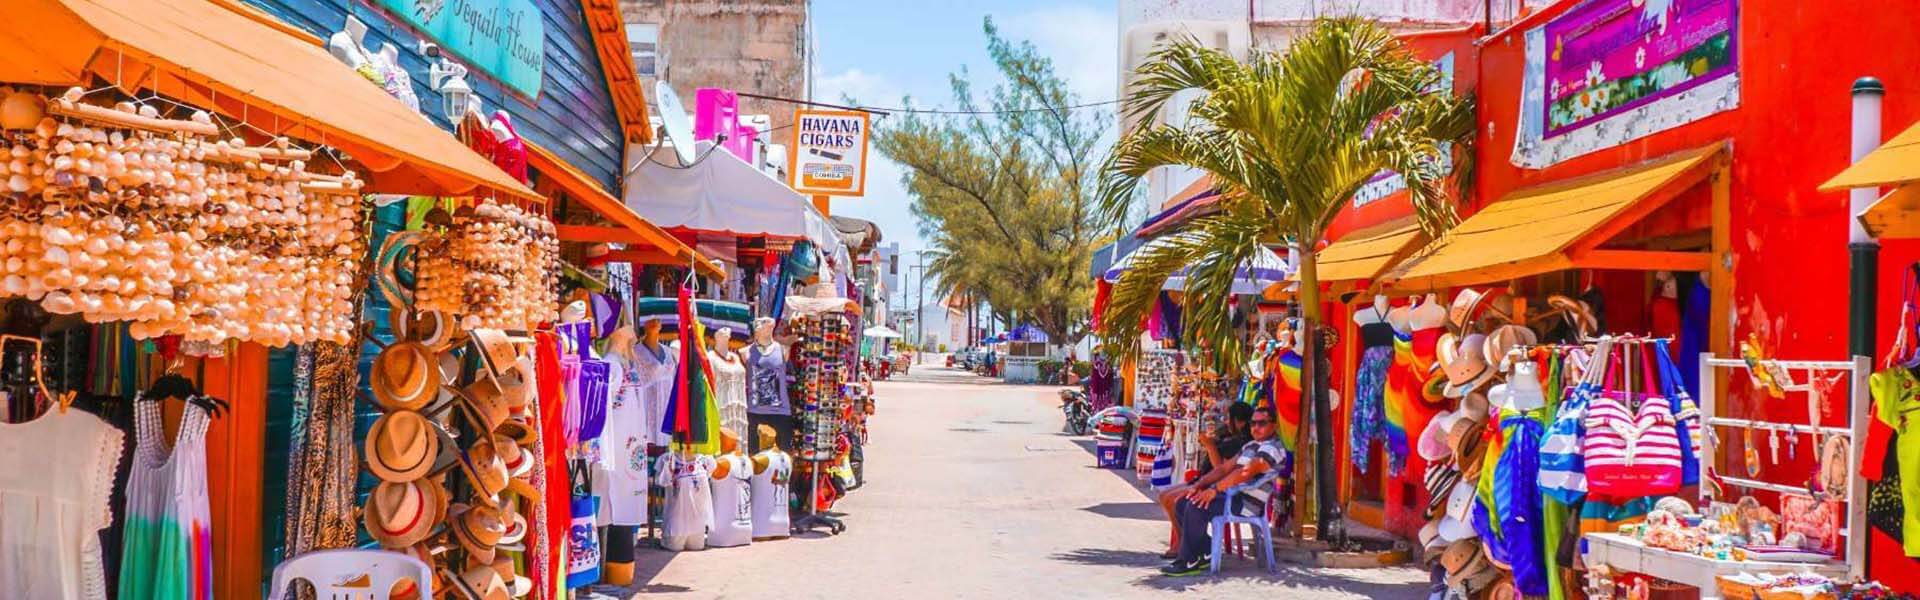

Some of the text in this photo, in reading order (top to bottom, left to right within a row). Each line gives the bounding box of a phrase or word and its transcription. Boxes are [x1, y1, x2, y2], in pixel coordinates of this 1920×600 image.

[505, 8, 542, 73] House
[802, 117, 860, 134] HAVANA
[800, 132, 854, 148] CIGARS
